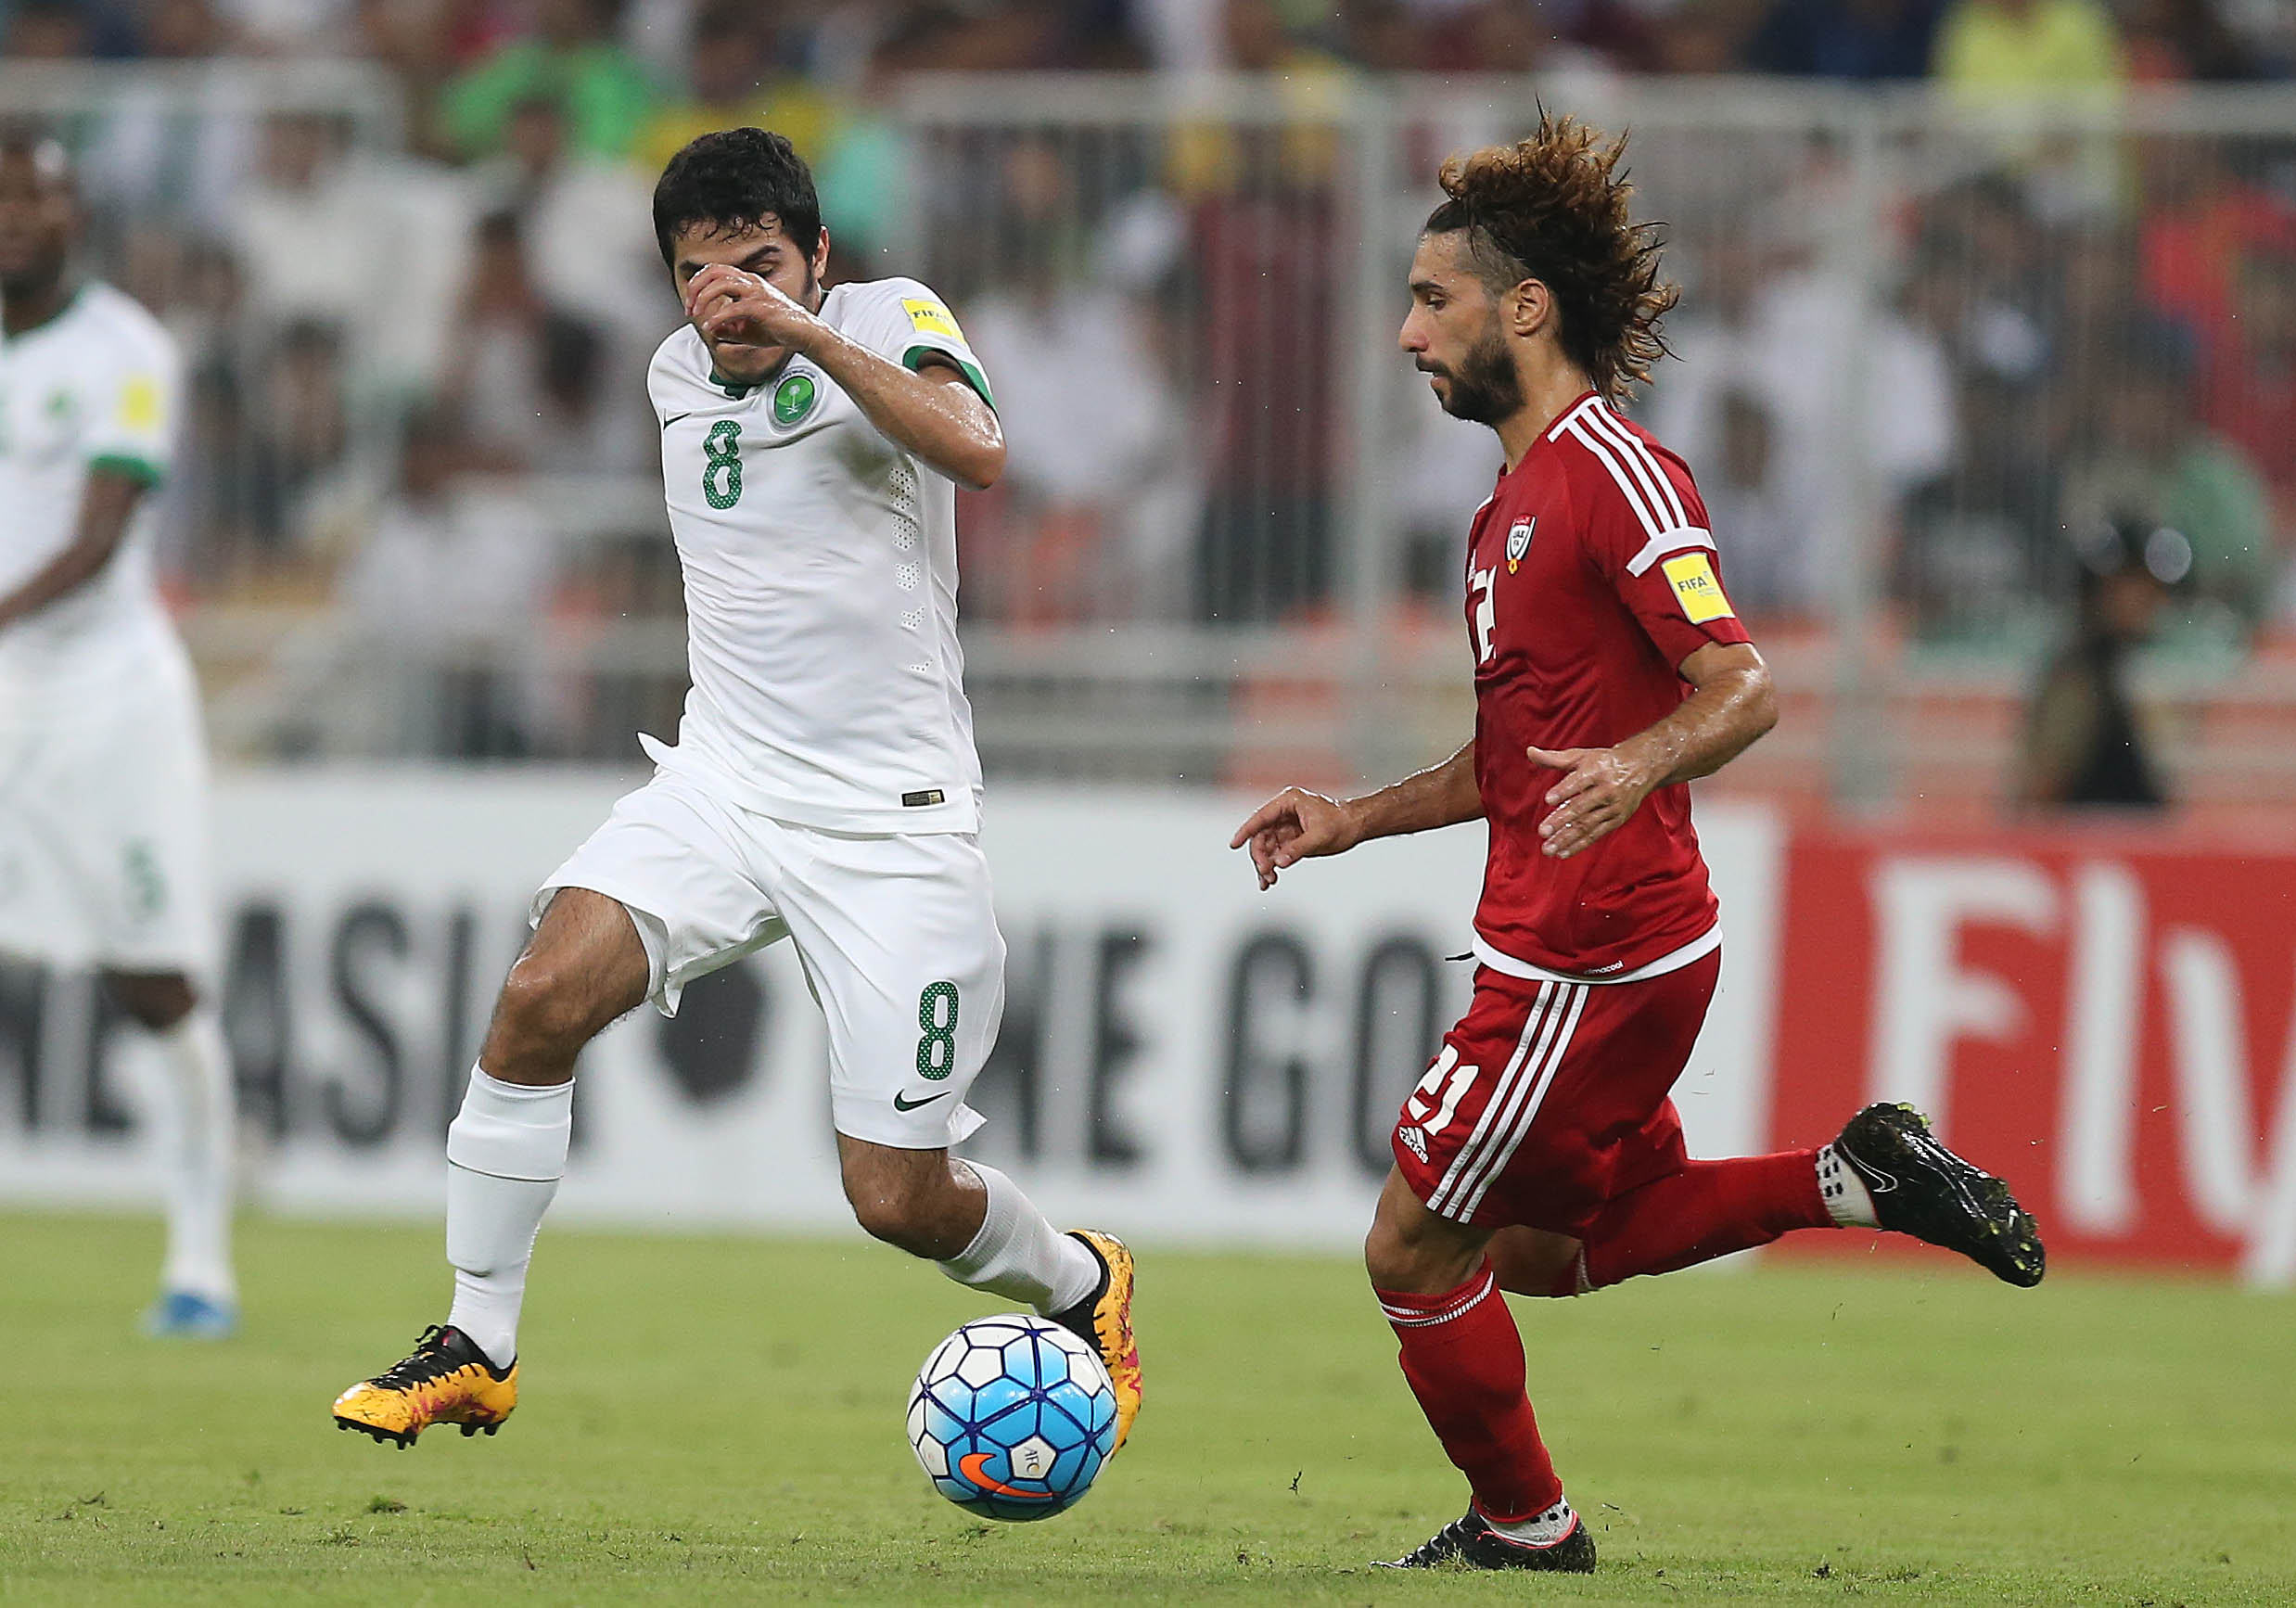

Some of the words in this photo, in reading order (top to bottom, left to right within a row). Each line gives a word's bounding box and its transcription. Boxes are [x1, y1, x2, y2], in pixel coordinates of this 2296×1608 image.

[703, 420, 743, 510] 8
[1677, 576, 1708, 593] FIFA
[915, 980, 959, 1080] 8
[1408, 1043, 1480, 1137] 21
